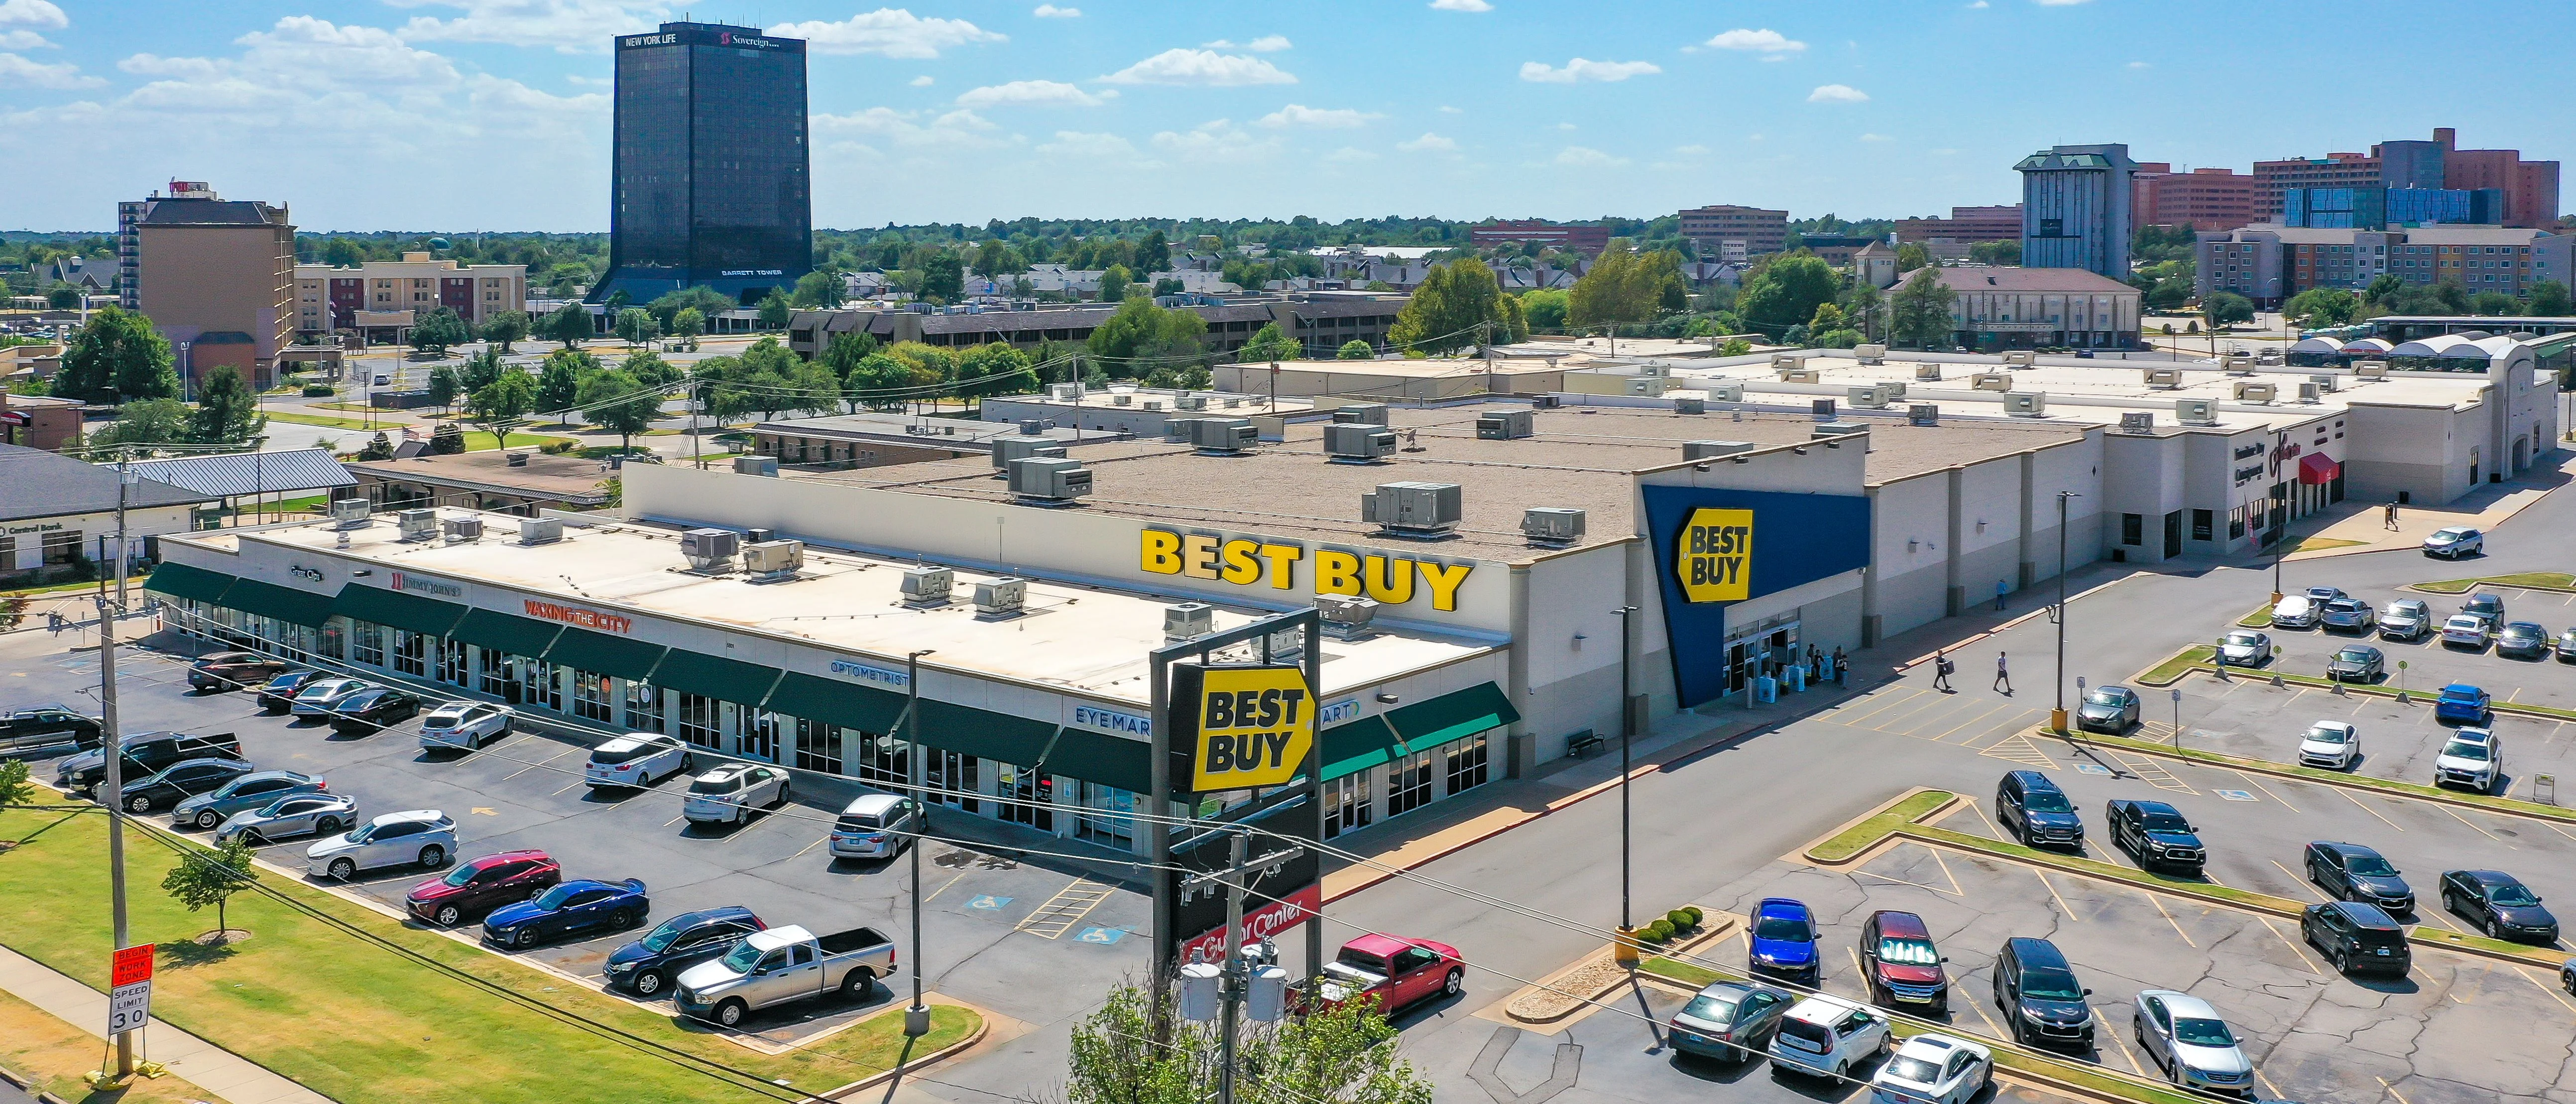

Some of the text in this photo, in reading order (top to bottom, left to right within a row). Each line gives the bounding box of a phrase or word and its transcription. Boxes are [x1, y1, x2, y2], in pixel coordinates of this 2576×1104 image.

[626, 34, 676, 46] NEW YORK LIFE
[733, 35, 768, 48] Sovereign
[9, 522, 63, 534] Central Bank
[1690, 525, 1749, 554] BEST
[1141, 529, 1475, 613] BEST BUY
[1691, 556, 1744, 586] BUY
[403, 577, 429, 591] JIMMY
[524, 599, 631, 634] WAXING THE CITY
[830, 662, 909, 686] OPTOMETRIST
[1204, 688, 1305, 730] BEST
[1076, 708, 1151, 737] EYEMAR
[1205, 731, 1294, 774] BUY
[119, 948, 148, 959] BEGIN
[118, 962, 146, 972] WORK
[119, 971, 144, 982] ZONE
[115, 985, 147, 999] SPEED
[117, 997, 143, 1010] LIMIT
[113, 1009, 143, 1029] 30
